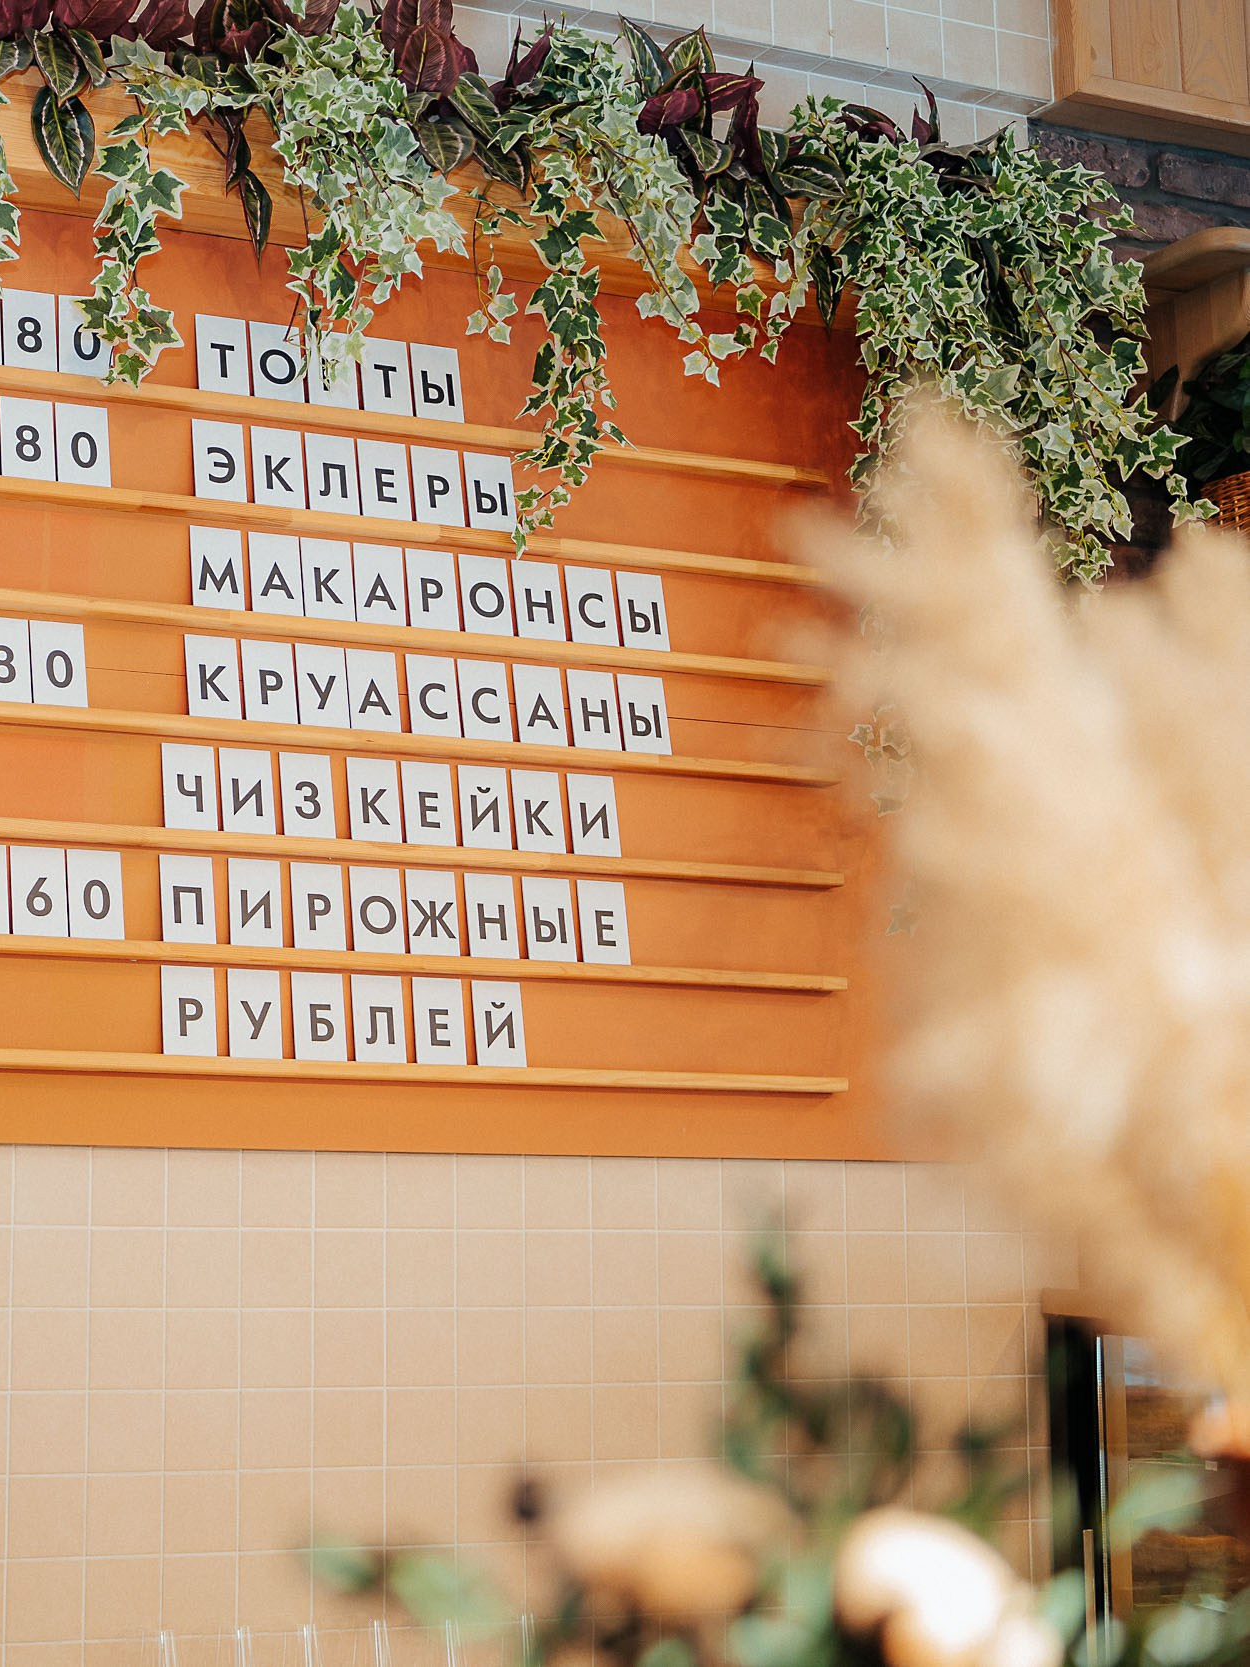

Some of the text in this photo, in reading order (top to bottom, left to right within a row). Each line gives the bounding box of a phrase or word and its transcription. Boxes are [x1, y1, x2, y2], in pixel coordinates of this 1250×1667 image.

[207, 447, 508, 516] ЭКЛЕРЫ
[199, 554, 661, 635] МАКАРОНСЫ
[199, 663, 662, 738] КРУАССАНЫ
[177, 774, 609, 839] ЧИЗКЕЙКИ
[173, 886, 616, 946] ПИРОЖНЫЕ
[179, 998, 515, 1048] РУБЛЕЙ
